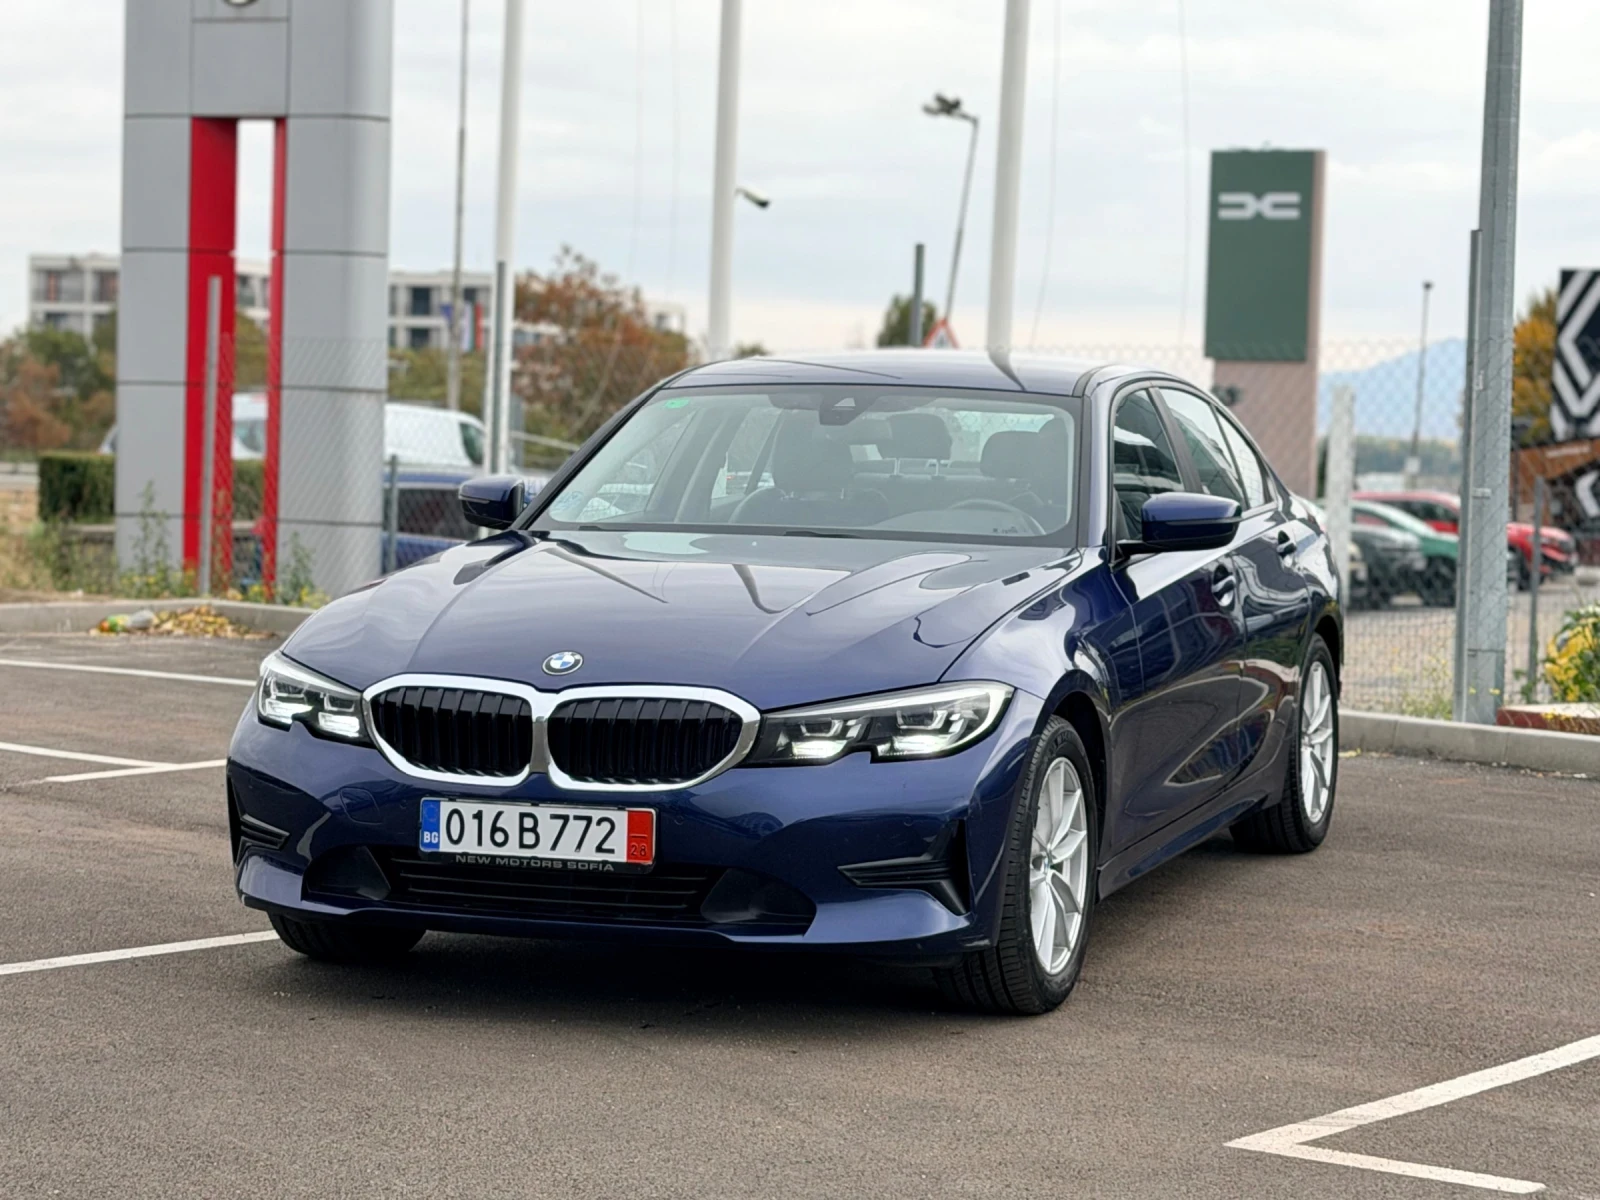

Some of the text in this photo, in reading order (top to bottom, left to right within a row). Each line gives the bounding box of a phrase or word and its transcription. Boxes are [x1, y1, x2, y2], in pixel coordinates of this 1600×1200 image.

[423, 831, 439, 844] BG
[630, 842, 647, 857] 28
[455, 854, 615, 872] NEW MOTORS SOFIA
